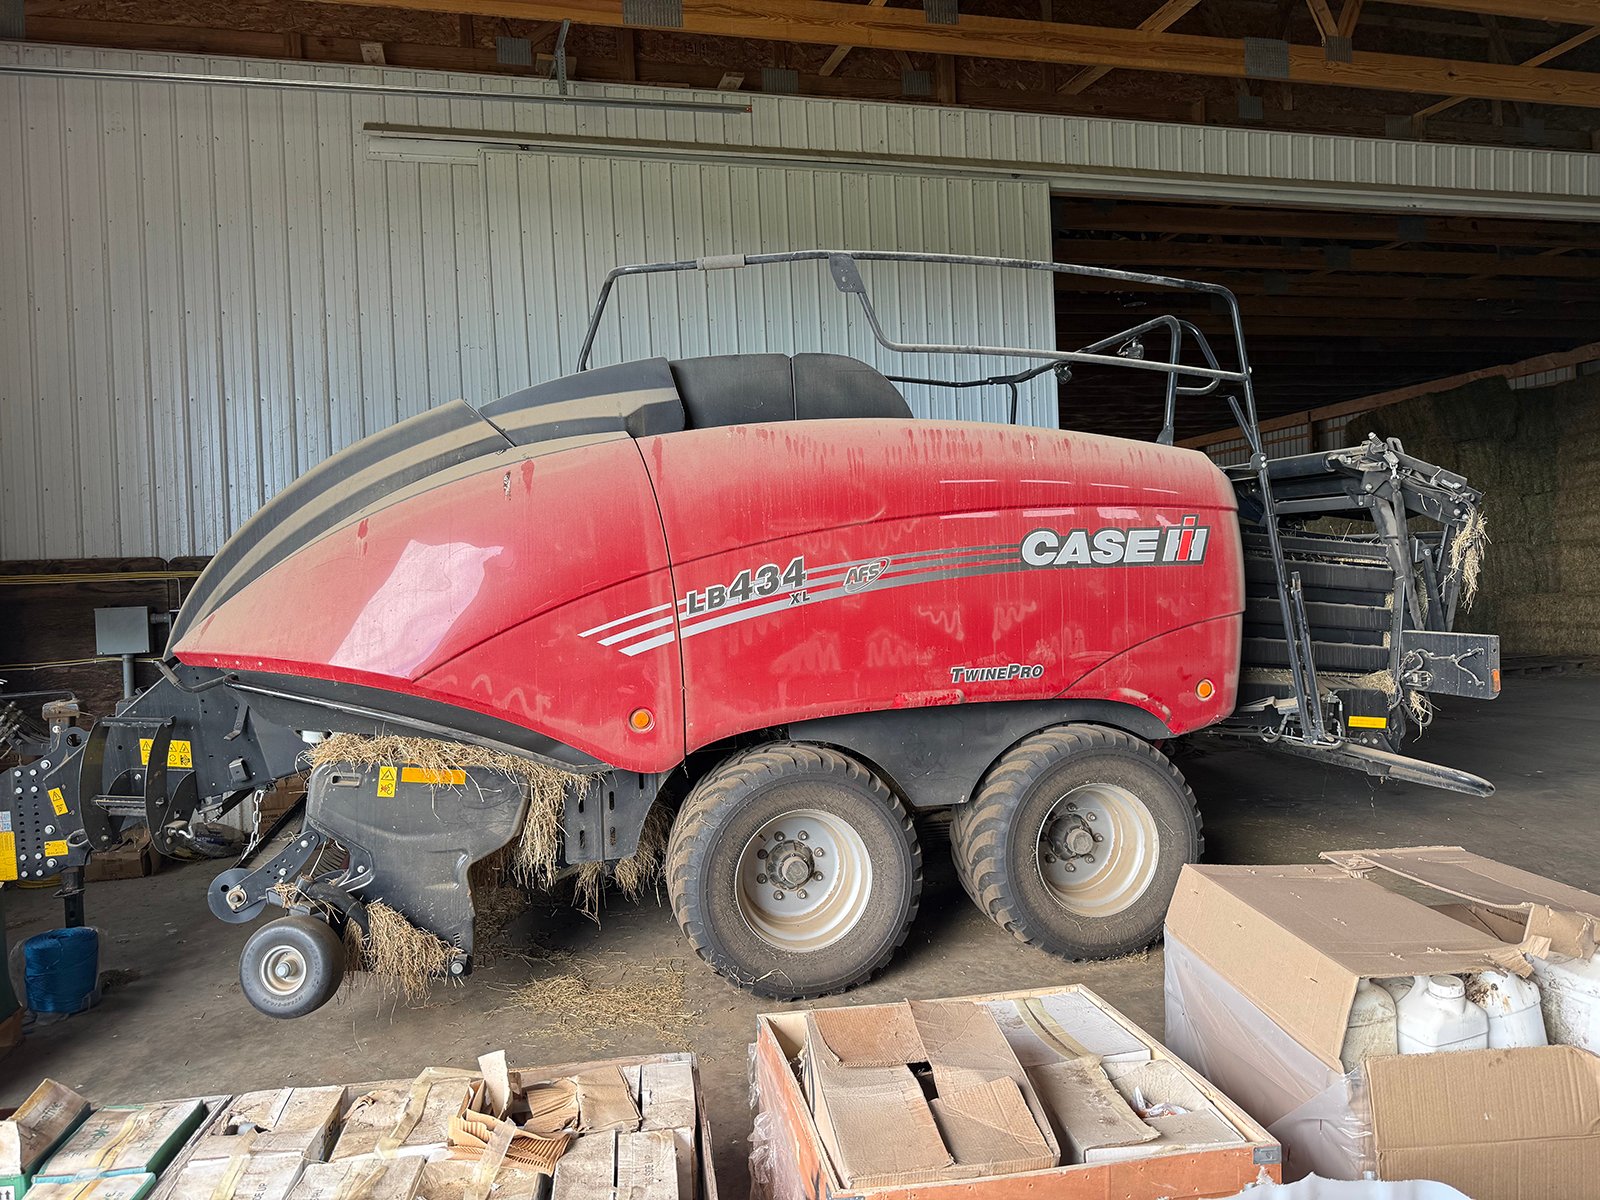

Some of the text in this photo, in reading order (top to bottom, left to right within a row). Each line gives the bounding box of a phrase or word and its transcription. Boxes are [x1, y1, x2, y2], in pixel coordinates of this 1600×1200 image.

[1020, 527, 1161, 567] CASE
[686, 556, 807, 617] LB434
[843, 561, 882, 587] AFS
[788, 590, 811, 606] XL
